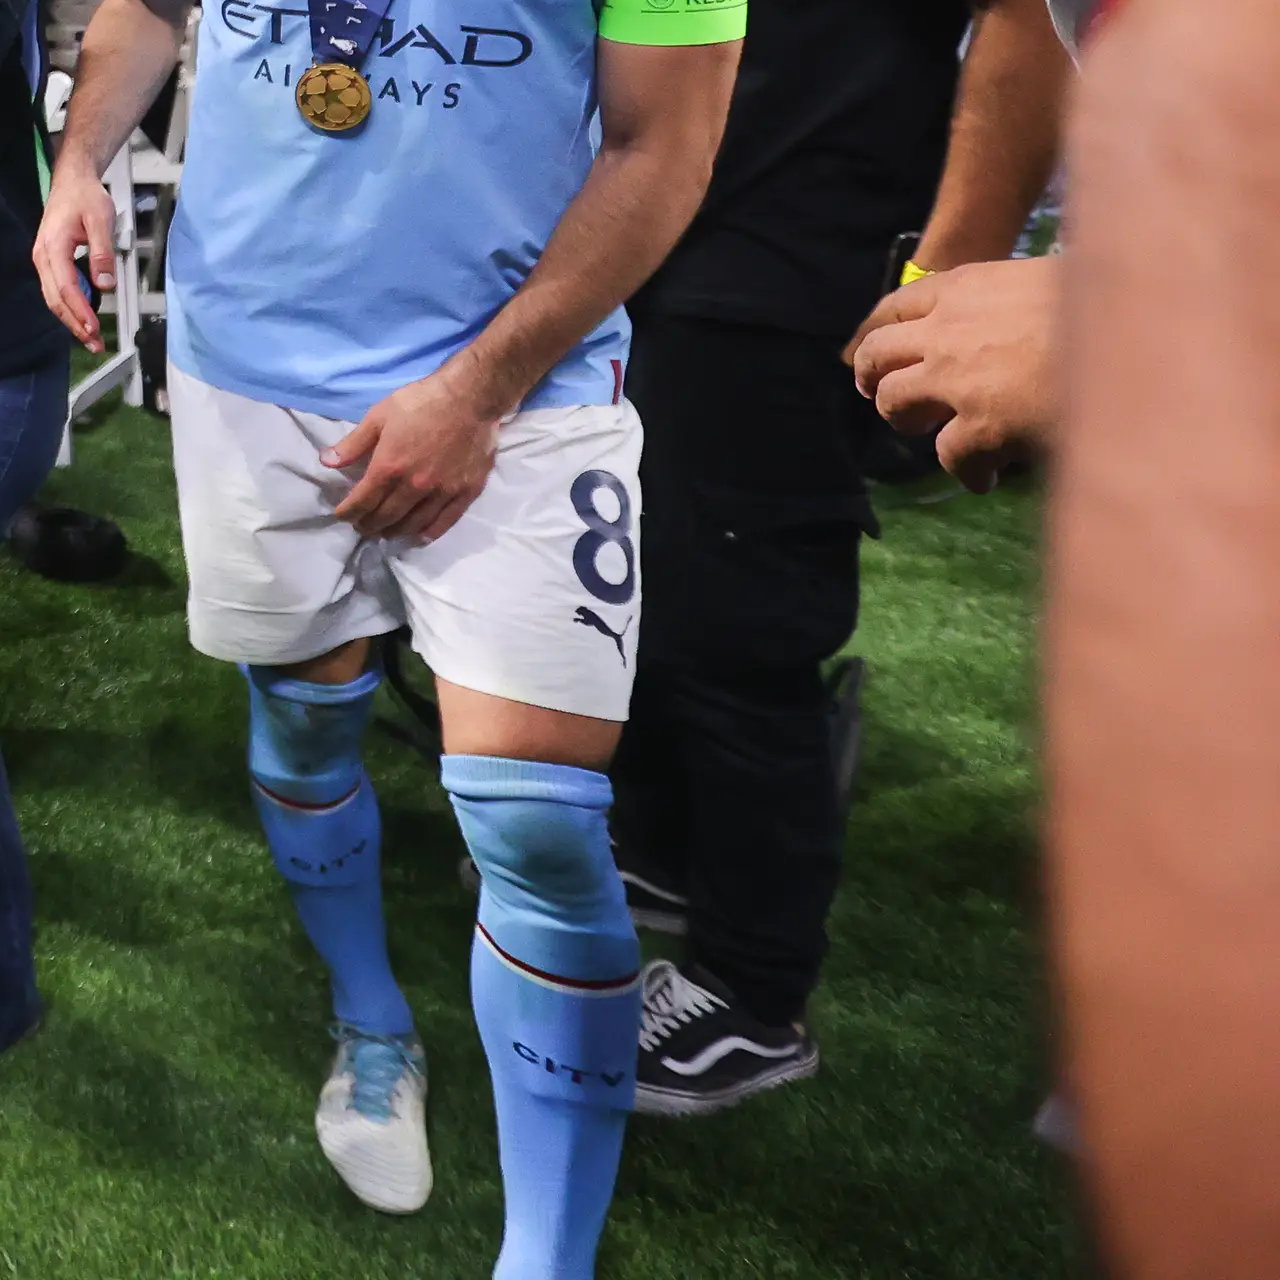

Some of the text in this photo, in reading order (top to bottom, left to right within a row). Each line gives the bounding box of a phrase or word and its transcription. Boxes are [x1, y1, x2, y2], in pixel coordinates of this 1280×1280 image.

[253, 58, 462, 110] AIAYS
[568, 469, 635, 605] 8
[512, 1041, 626, 1088] CITY
